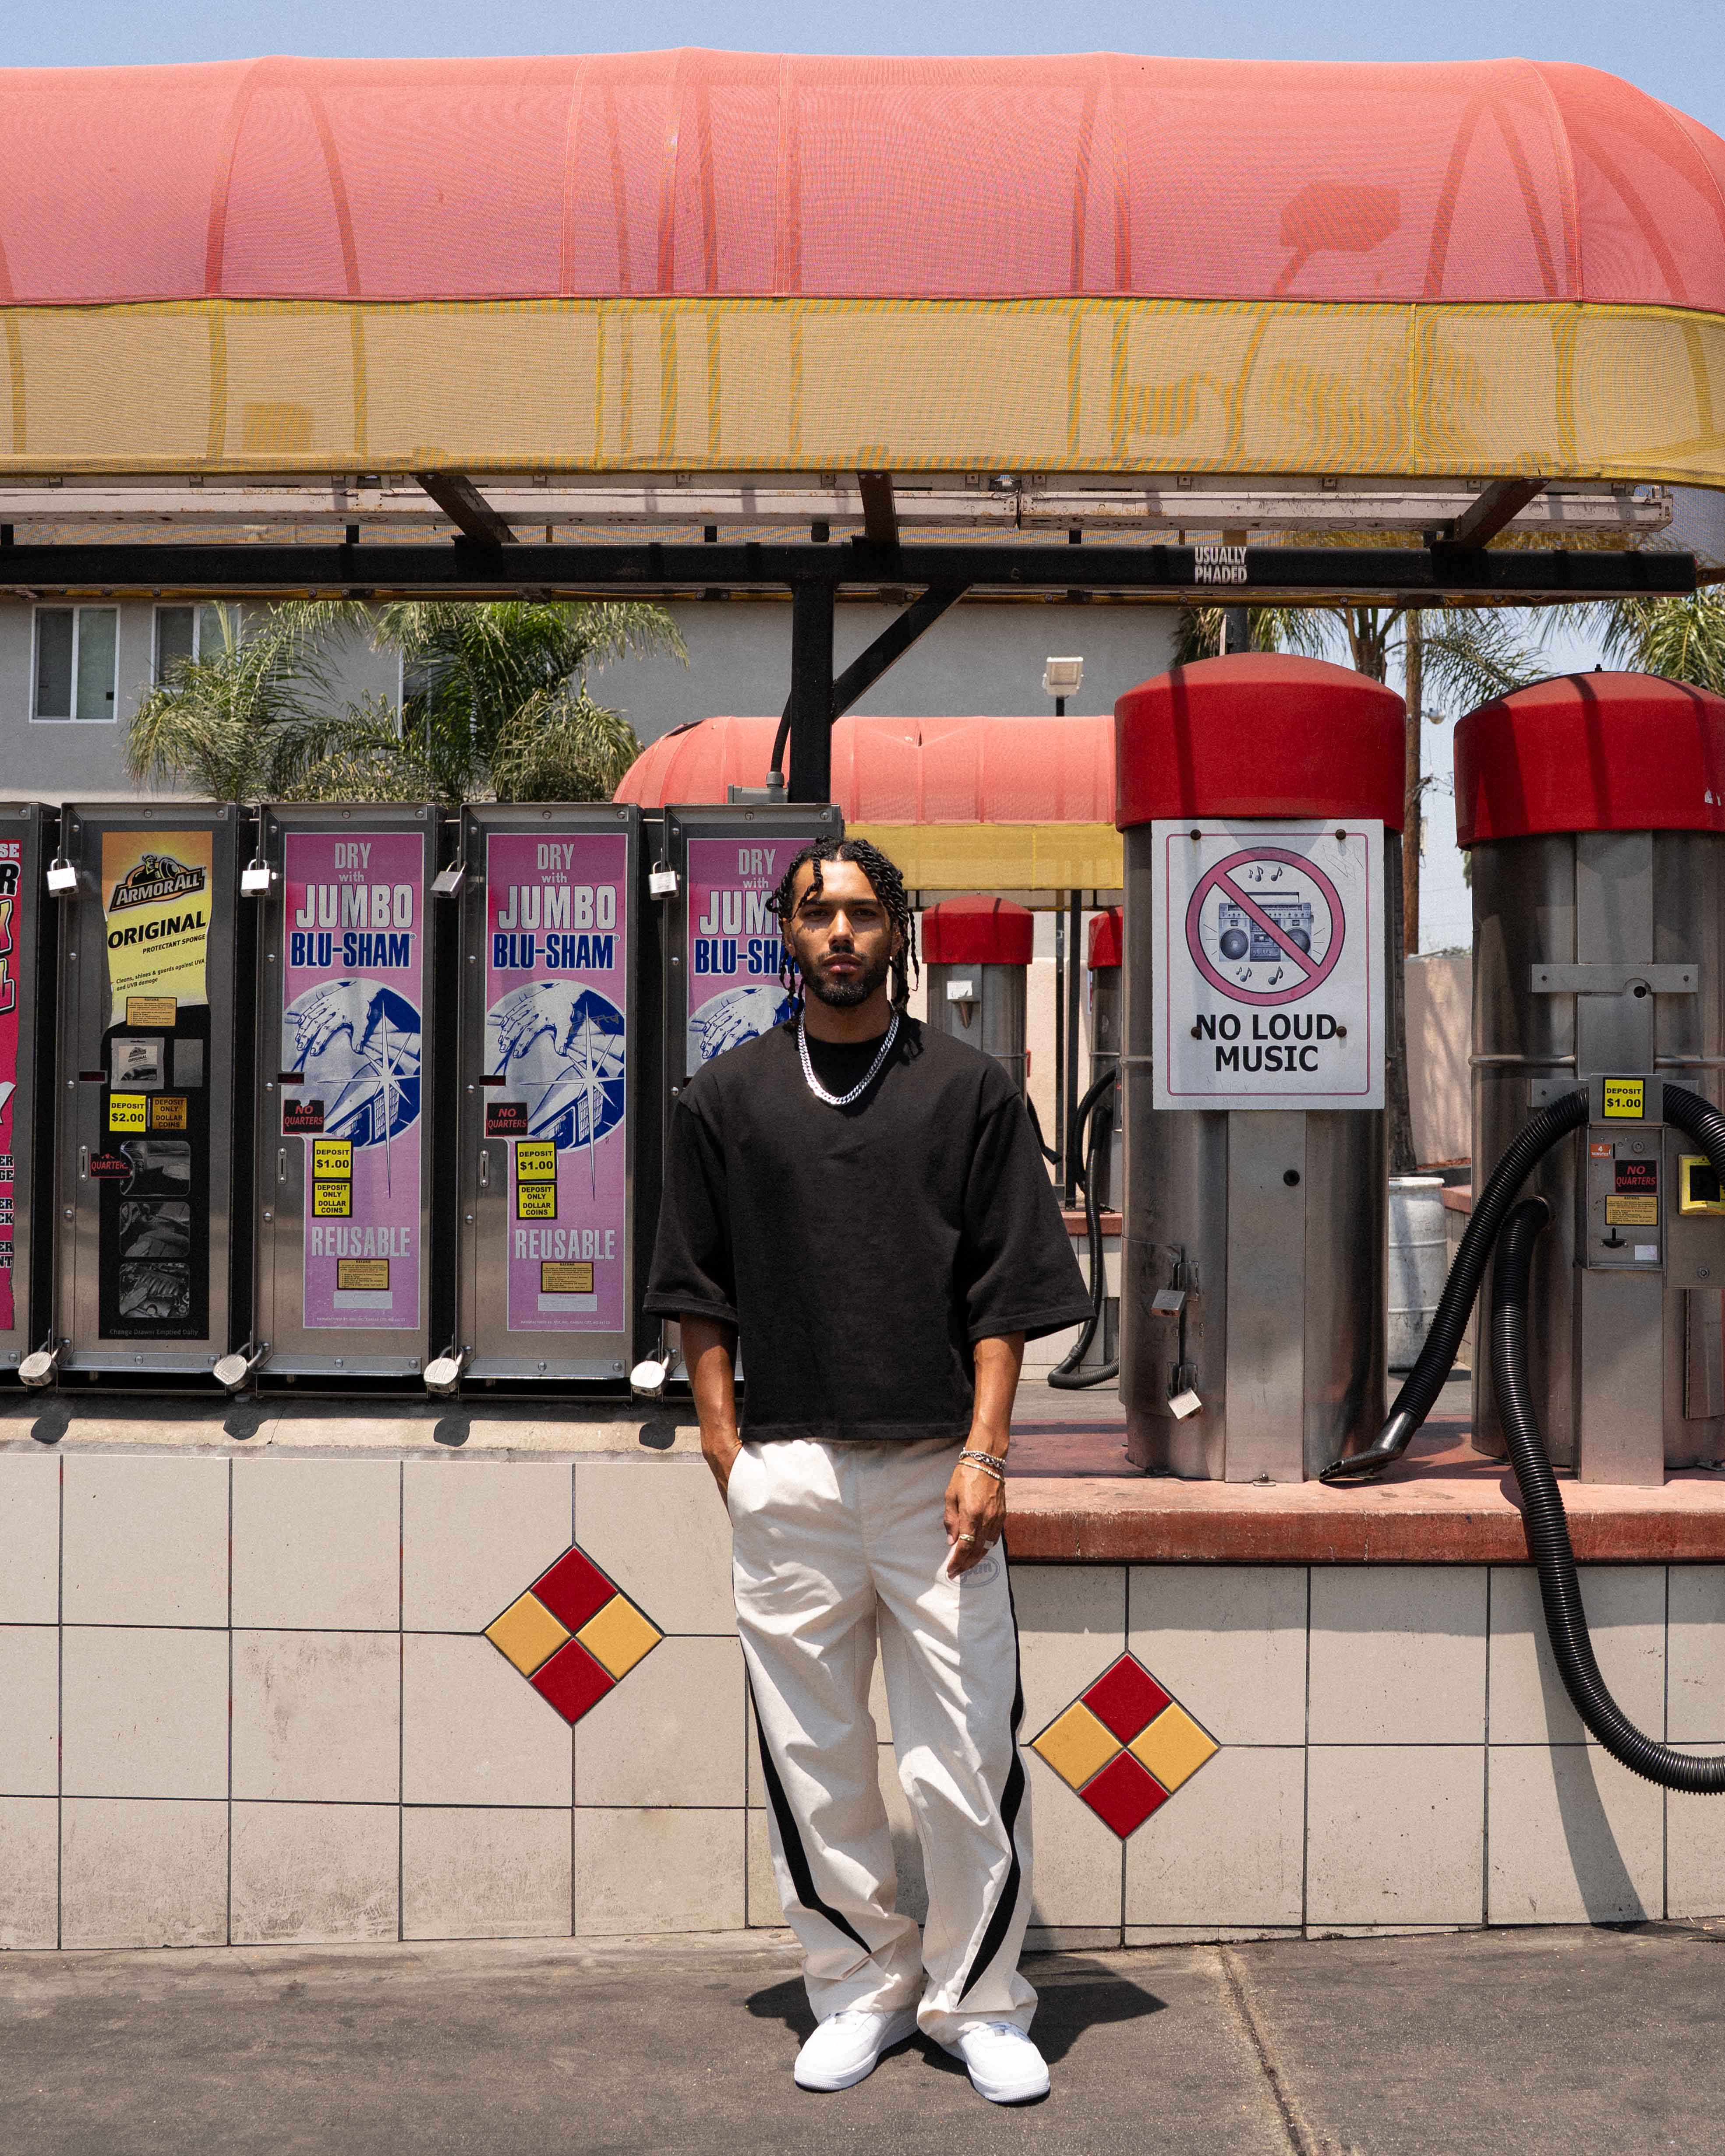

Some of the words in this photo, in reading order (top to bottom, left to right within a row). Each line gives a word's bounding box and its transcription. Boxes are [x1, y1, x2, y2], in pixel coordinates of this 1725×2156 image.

[1195, 546, 1247, 565] USUALLY
[1195, 565, 1247, 584] PHADED
[335, 843, 371, 869] DRY
[537, 844, 575, 869] DRY
[739, 849, 776, 875] DRY
[339, 871, 364, 882] with
[541, 872, 567, 883] with
[743, 877, 769, 888] with
[295, 884, 414, 928] JUMBO
[498, 885, 617, 929] JUMBO
[699, 890, 783, 935] JUM
[108, 910, 206, 949] ORIGINAL
[142, 940, 180, 954] PROTECTANT
[182, 934, 205, 945] SPONGE
[290, 932, 410, 967] BLU-SHAM
[493, 933, 614, 969] BLU-SHAM
[157, 966, 174, 975] guards
[175, 961, 194, 971] against
[138, 977, 158, 986] damage
[1196, 1014, 1241, 1041] NO
[1252, 1014, 1337, 1041] LOUD
[1216, 1045, 1318, 1072] MUSIC
[295, 1105, 314, 1115] NO
[1606, 1097, 1641, 1108] $1.00
[112, 1113, 144, 1122] $2.00
[498, 1108, 517, 1117] NO
[285, 1116, 323, 1127] QUARTERS
[488, 1119, 527, 1129] QUARTERS
[91, 1161, 129, 1172] QUARTER
[316, 1159, 349, 1169] $1.00
[520, 1161, 553, 1171] $1.00
[1627, 1165, 1646, 1175] NO
[1616, 1177, 1656, 1187] QUARTERS
[311, 1226, 410, 1257] REUSABLE
[515, 1229, 615, 1260] REUSABLE
